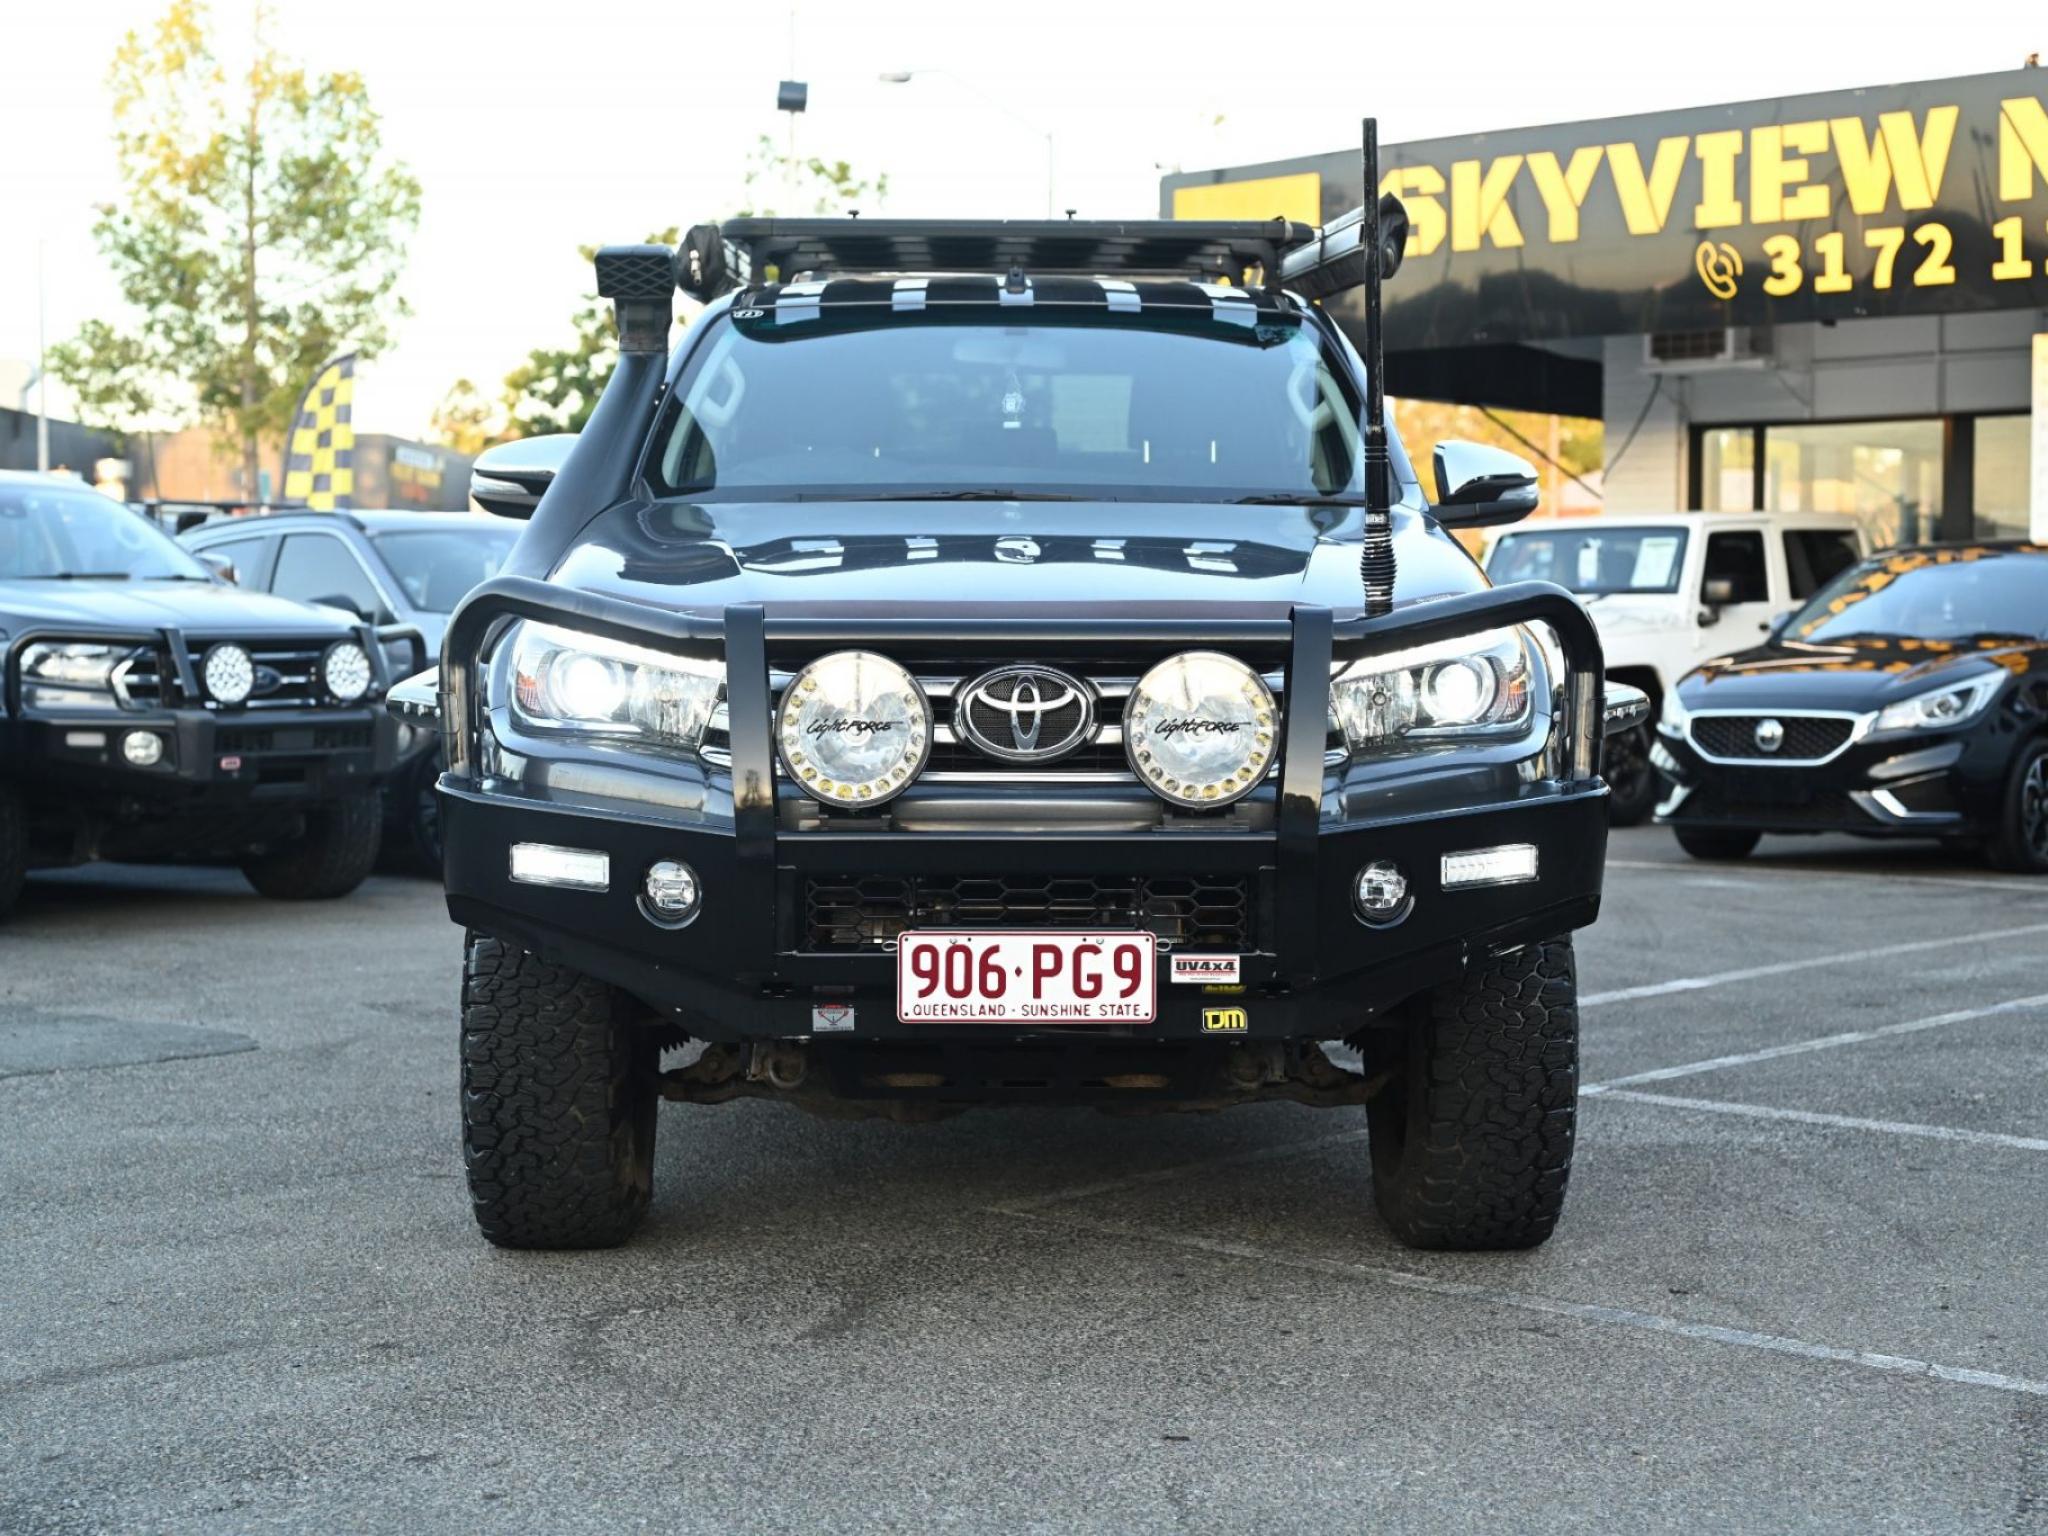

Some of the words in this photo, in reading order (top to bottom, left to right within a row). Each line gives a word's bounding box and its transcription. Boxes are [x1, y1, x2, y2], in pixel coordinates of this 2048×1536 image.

[1378, 105, 1959, 257] SKYVIEW
[1762, 223, 1955, 295] 3172
[1175, 961, 1236, 971] UV4x4
[913, 1004, 1006, 1017] QUEENSLAND
[1021, 1004, 1091, 1017] SUNSHINE
[1099, 1004, 1141, 1017] STATE
